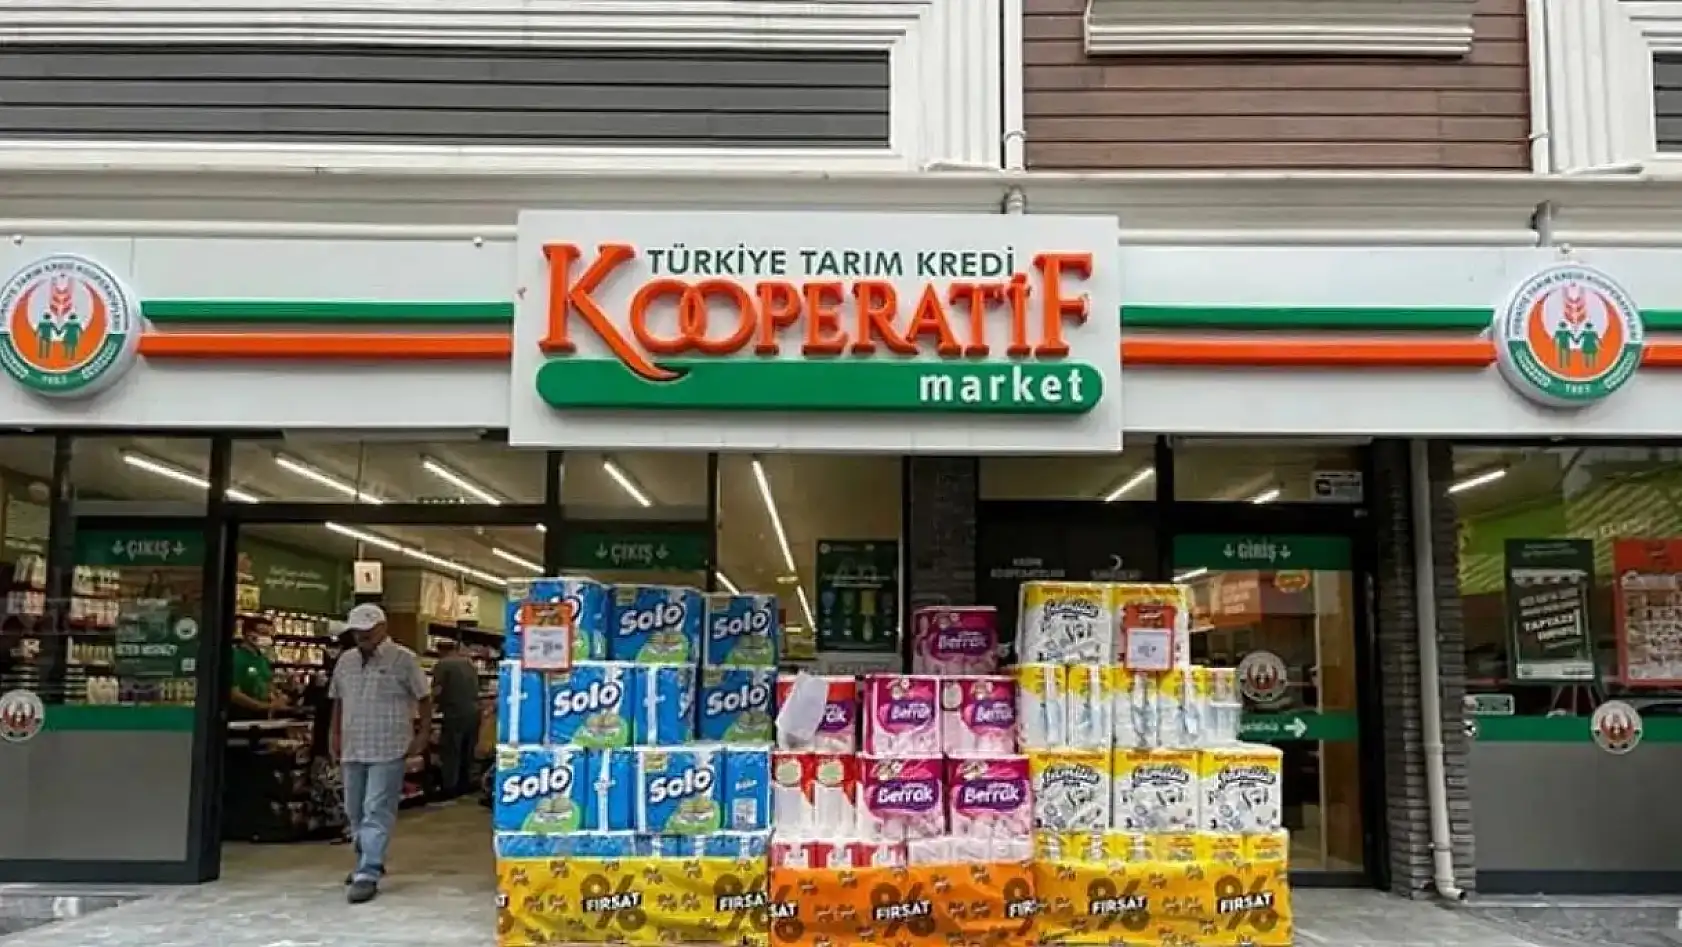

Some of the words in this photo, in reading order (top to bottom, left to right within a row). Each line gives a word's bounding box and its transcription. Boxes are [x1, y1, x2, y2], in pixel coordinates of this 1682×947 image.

[647, 242, 787, 276] TÜRKİYE
[800, 248, 903, 277] TARIM
[916, 246, 1015, 278] KREDİ
[539, 243, 1094, 380] KOOPERATİF
[919, 366, 1085, 402] market
[619, 602, 683, 636] Solo
[712, 607, 768, 639] Solo
[553, 681, 620, 716] Solo
[706, 683, 767, 716] Solo
[502, 766, 570, 802] Solo
[650, 768, 712, 803] Solo
[877, 783, 933, 802] Berrak
[963, 783, 1020, 802] Berrak
[876, 900, 930, 920] FIRSAT
[1092, 895, 1146, 915] FIRSAT
[1220, 893, 1273, 914] FIRSAT
